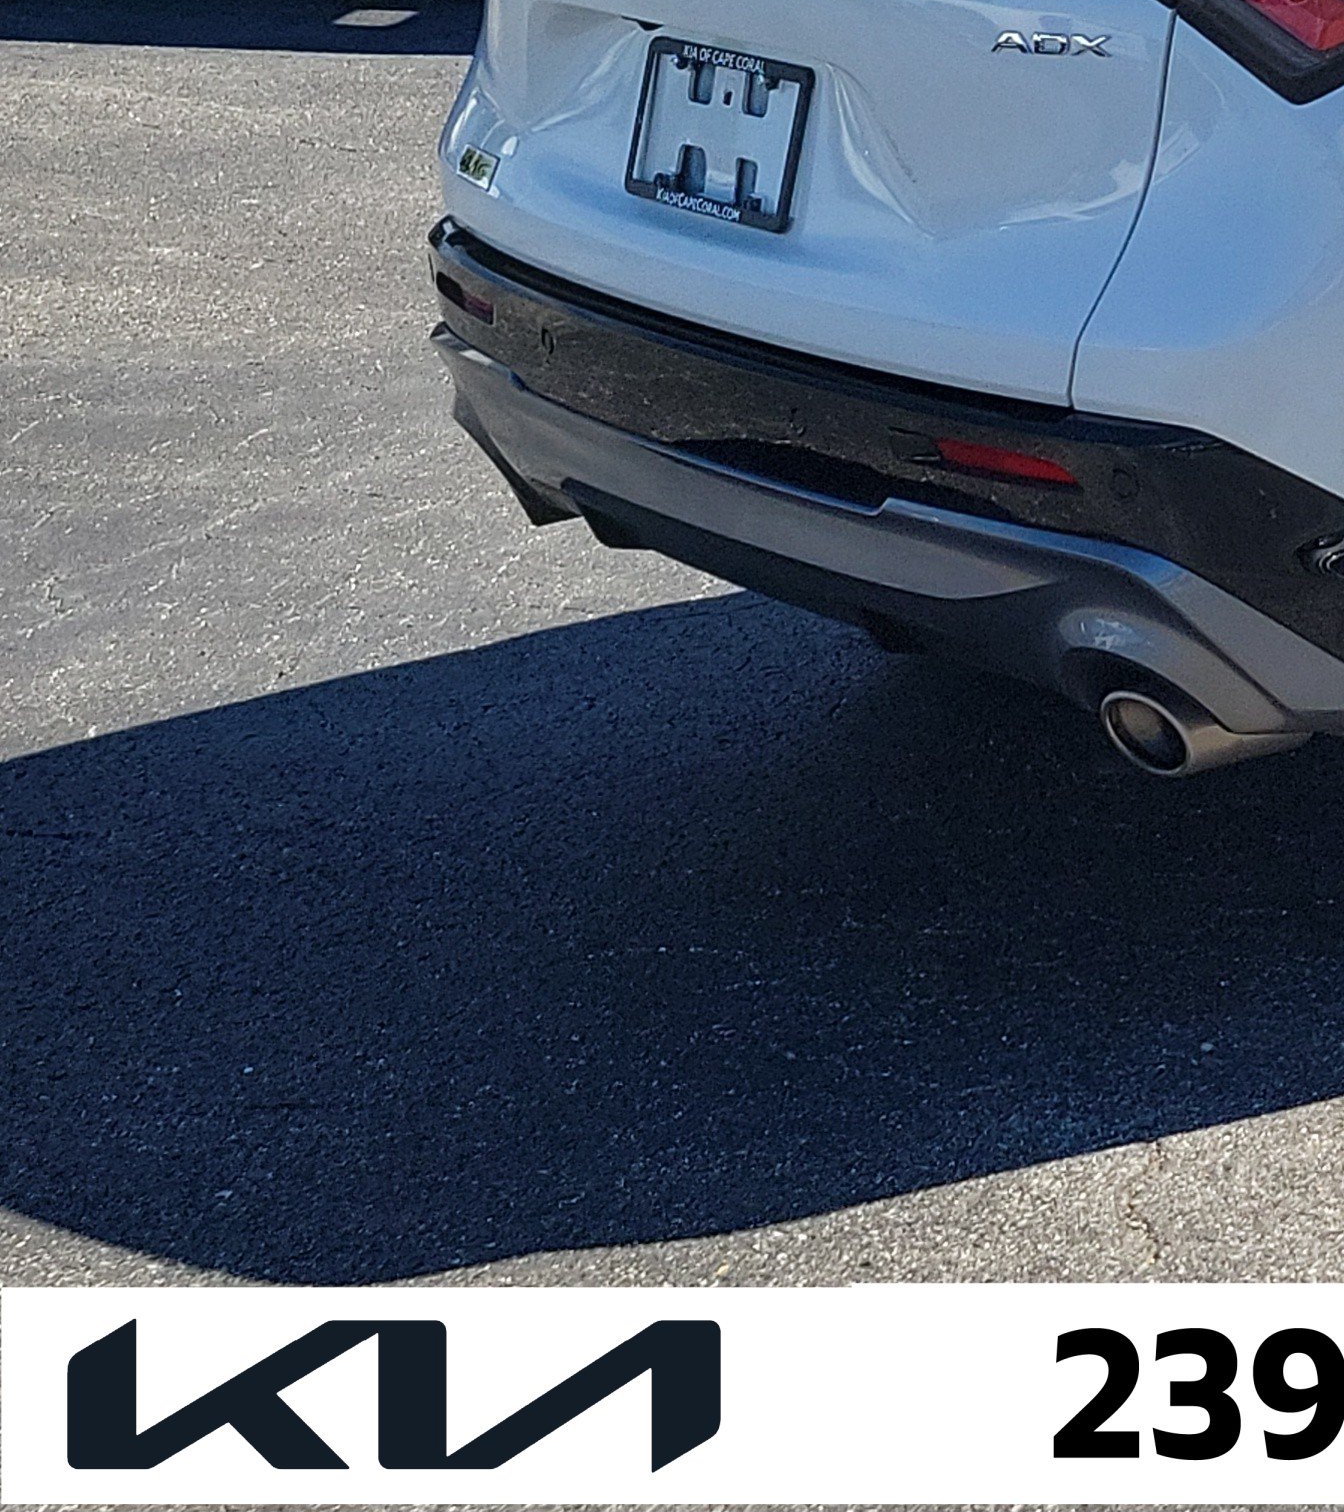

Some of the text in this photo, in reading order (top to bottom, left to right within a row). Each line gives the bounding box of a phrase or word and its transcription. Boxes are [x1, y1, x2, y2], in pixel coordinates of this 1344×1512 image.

[991, 30, 1112, 57] ADX
[699, 47, 712, 63] OF
[712, 50, 736, 68] CAPE
[736, 55, 765, 74] CORAL
